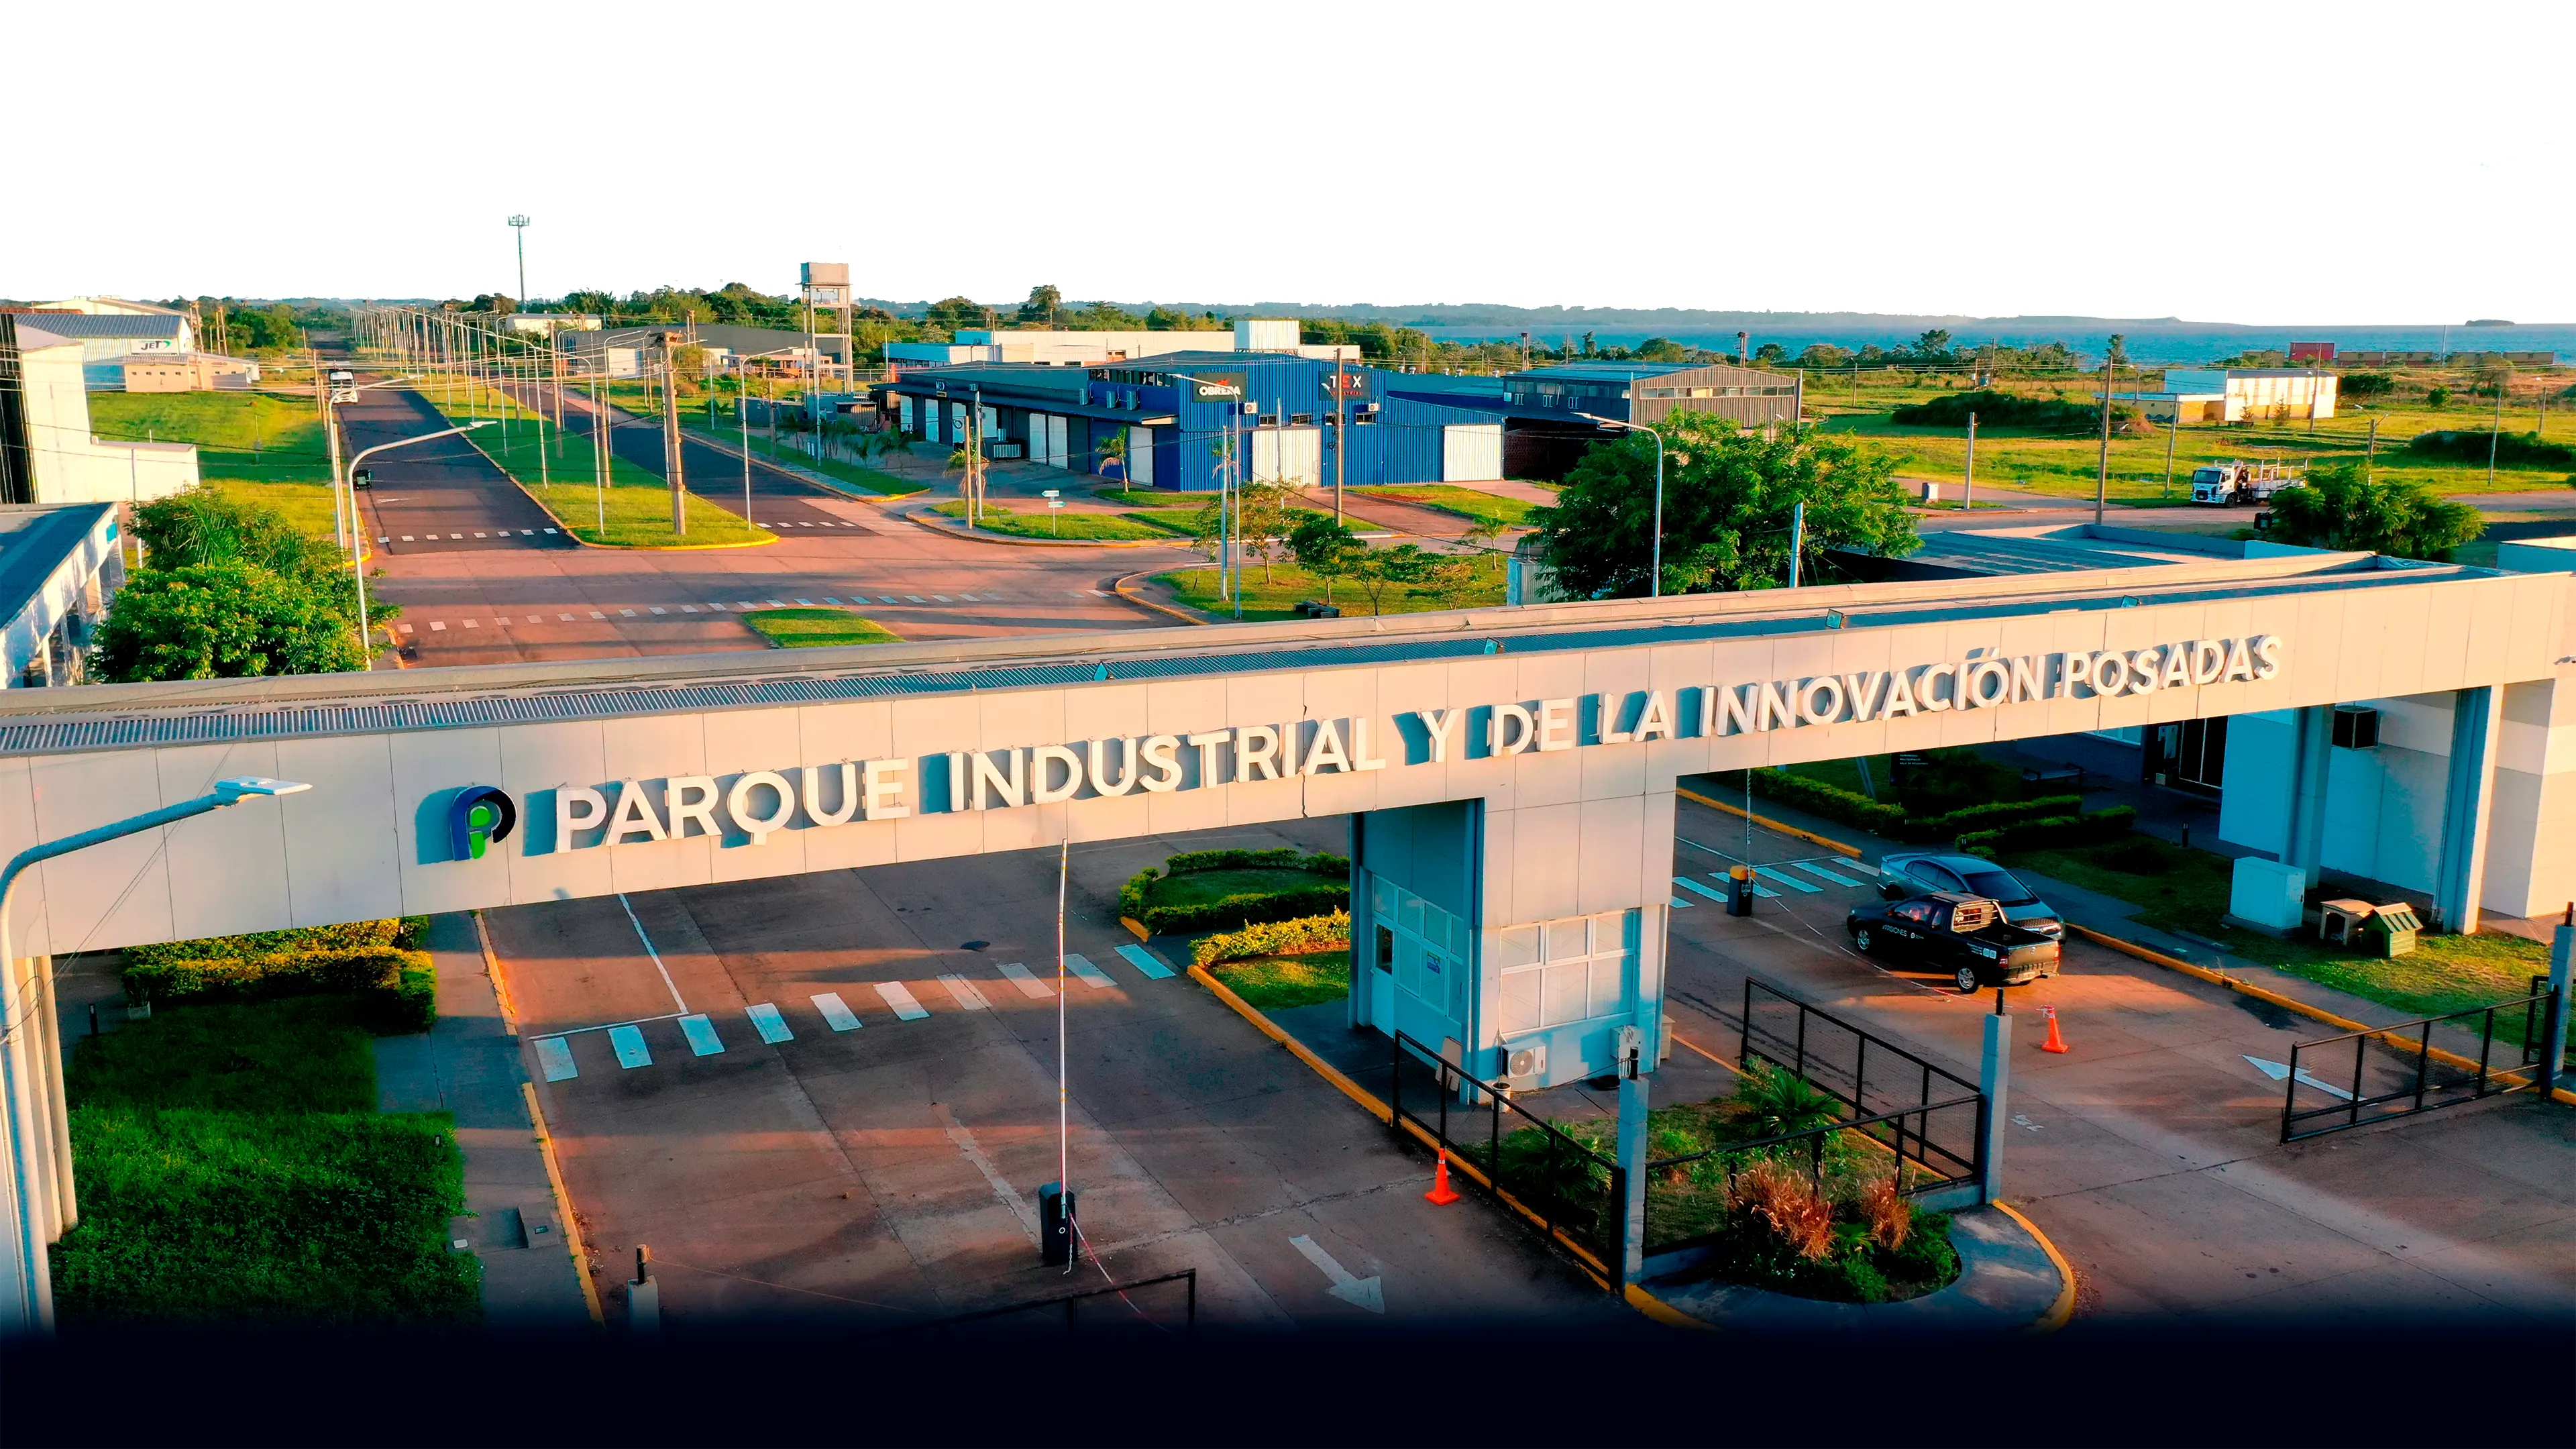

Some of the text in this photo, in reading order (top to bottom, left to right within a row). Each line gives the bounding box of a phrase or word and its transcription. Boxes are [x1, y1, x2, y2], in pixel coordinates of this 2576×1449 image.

[141, 341, 162, 350] JET
[1199, 386, 1241, 396] OBRERA
[555, 635, 2282, 853] PARQUE INDUSTRIAL Y DE LA INNOVACIÓN POSADAS
